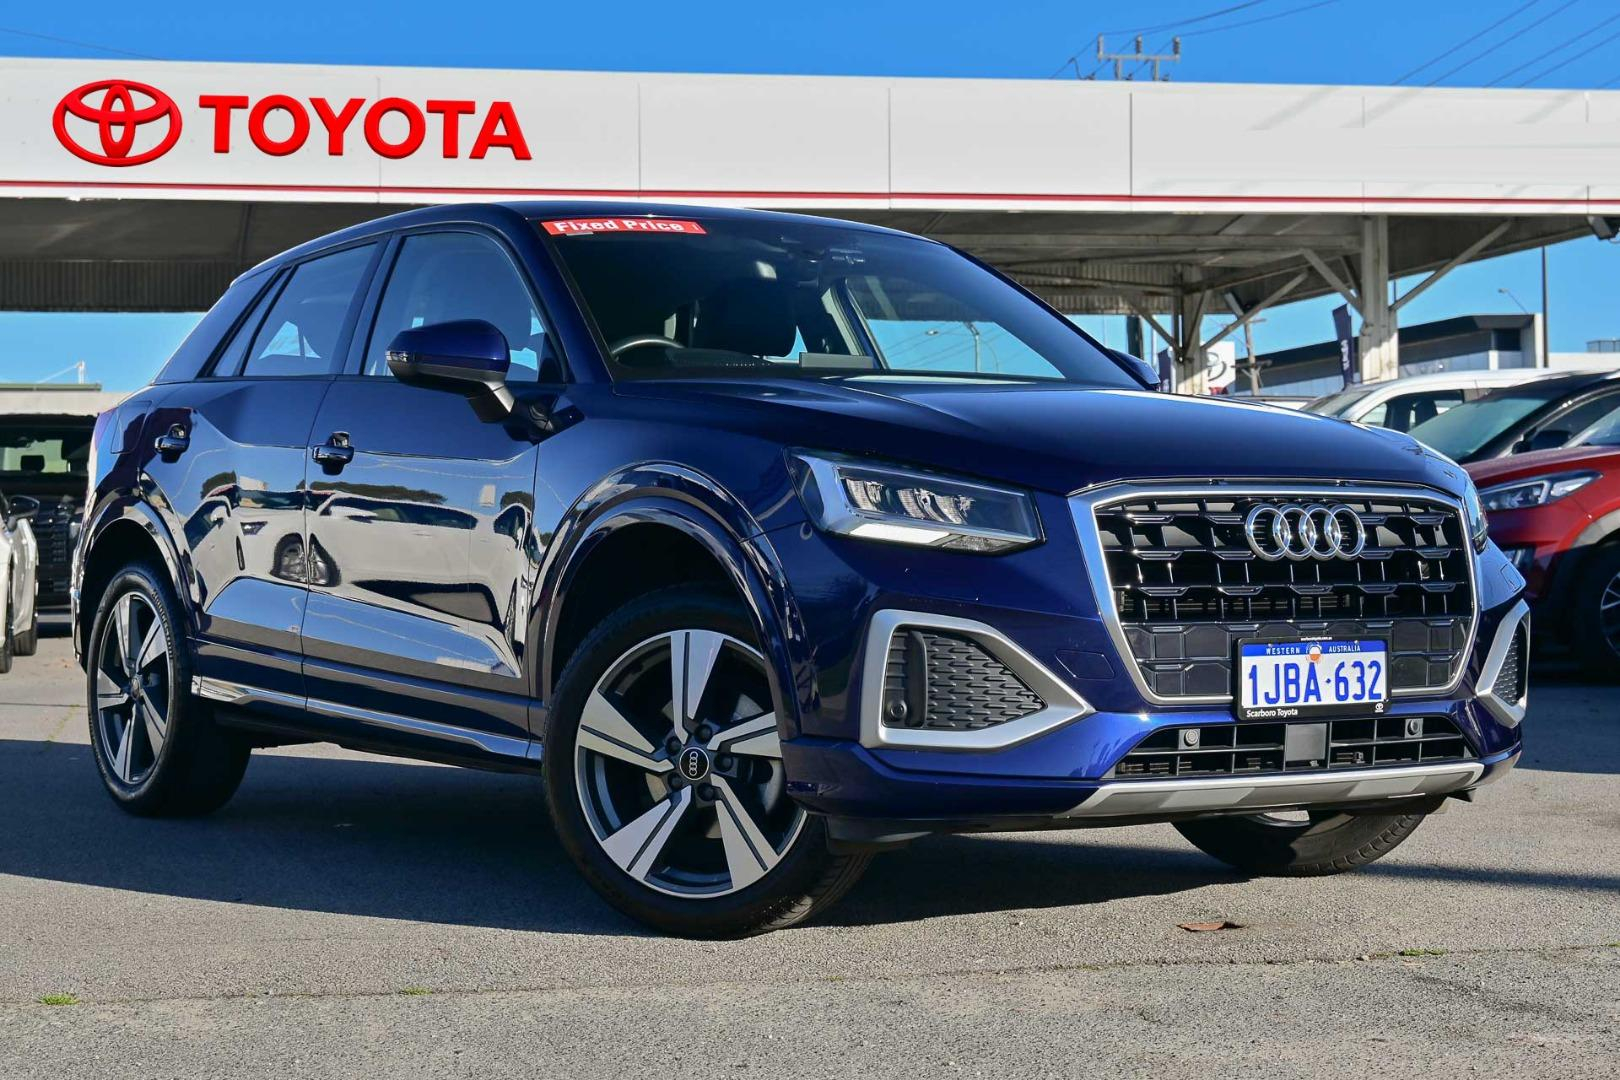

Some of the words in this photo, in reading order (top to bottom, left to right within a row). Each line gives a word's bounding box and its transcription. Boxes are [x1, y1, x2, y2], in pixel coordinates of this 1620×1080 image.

[199, 94, 532, 160] TOYOTA
[554, 219, 616, 232] Fixed
[621, 218, 684, 232] Price
[1265, 647, 1300, 655] WESTERN
[1328, 644, 1361, 653] AUSTRALIA
[1246, 709, 1277, 718] Scarboro
[1277, 708, 1298, 718] Toyota
